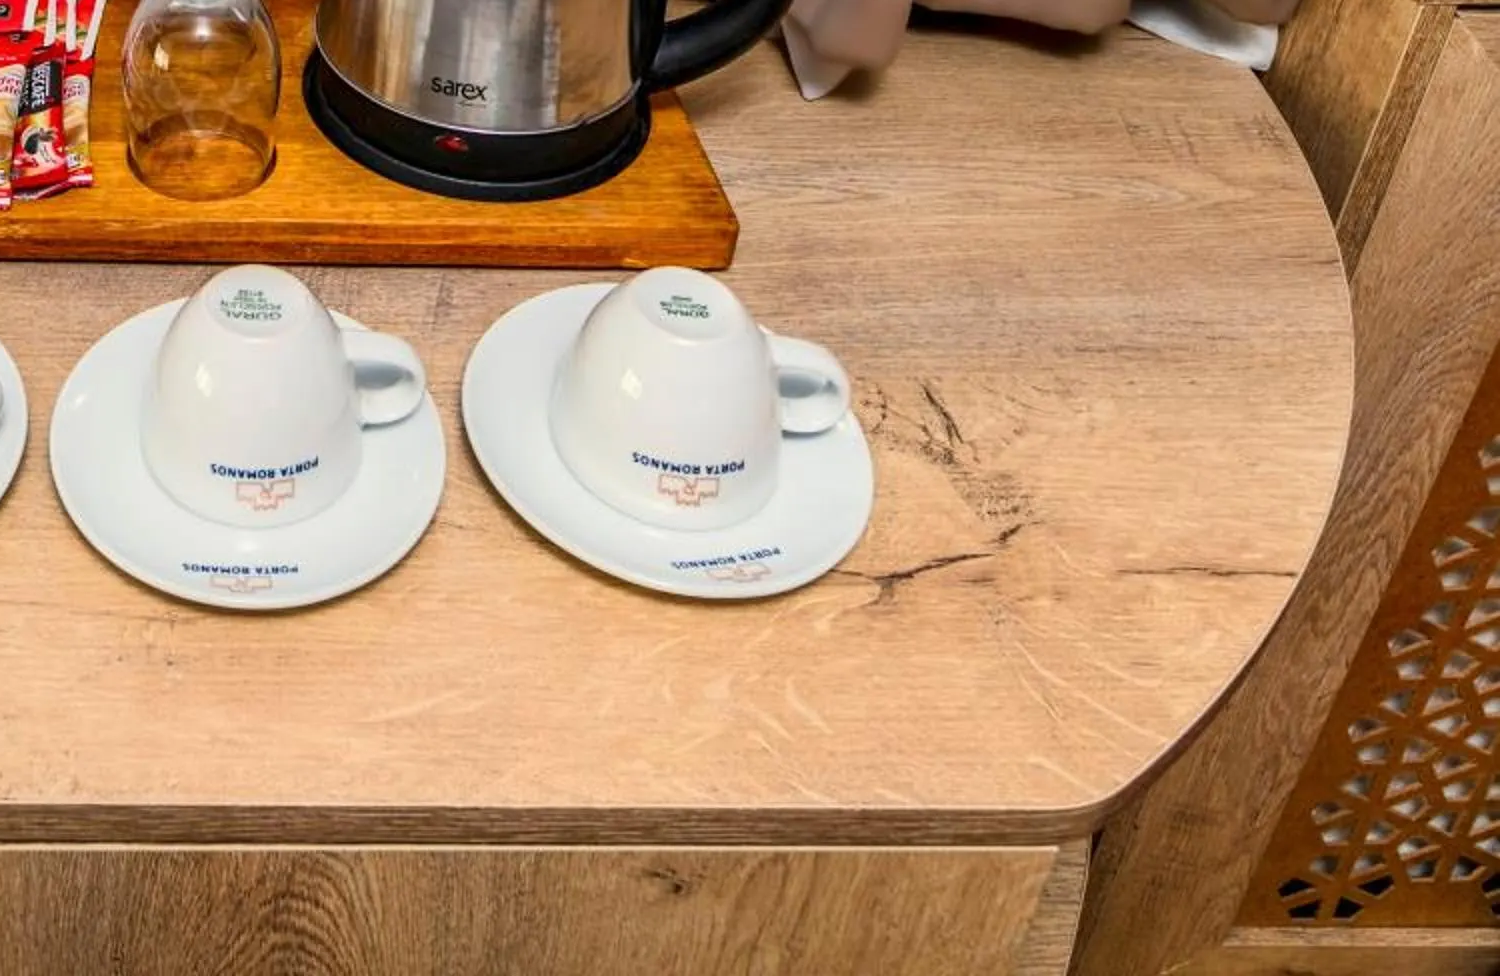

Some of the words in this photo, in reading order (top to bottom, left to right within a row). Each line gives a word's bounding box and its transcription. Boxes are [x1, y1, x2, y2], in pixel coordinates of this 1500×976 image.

[430, 76, 488, 101] sarex
[279, 455, 320, 475] PORTA
[705, 459, 746, 475] PORTA
[255, 565, 299, 575] PORTA
